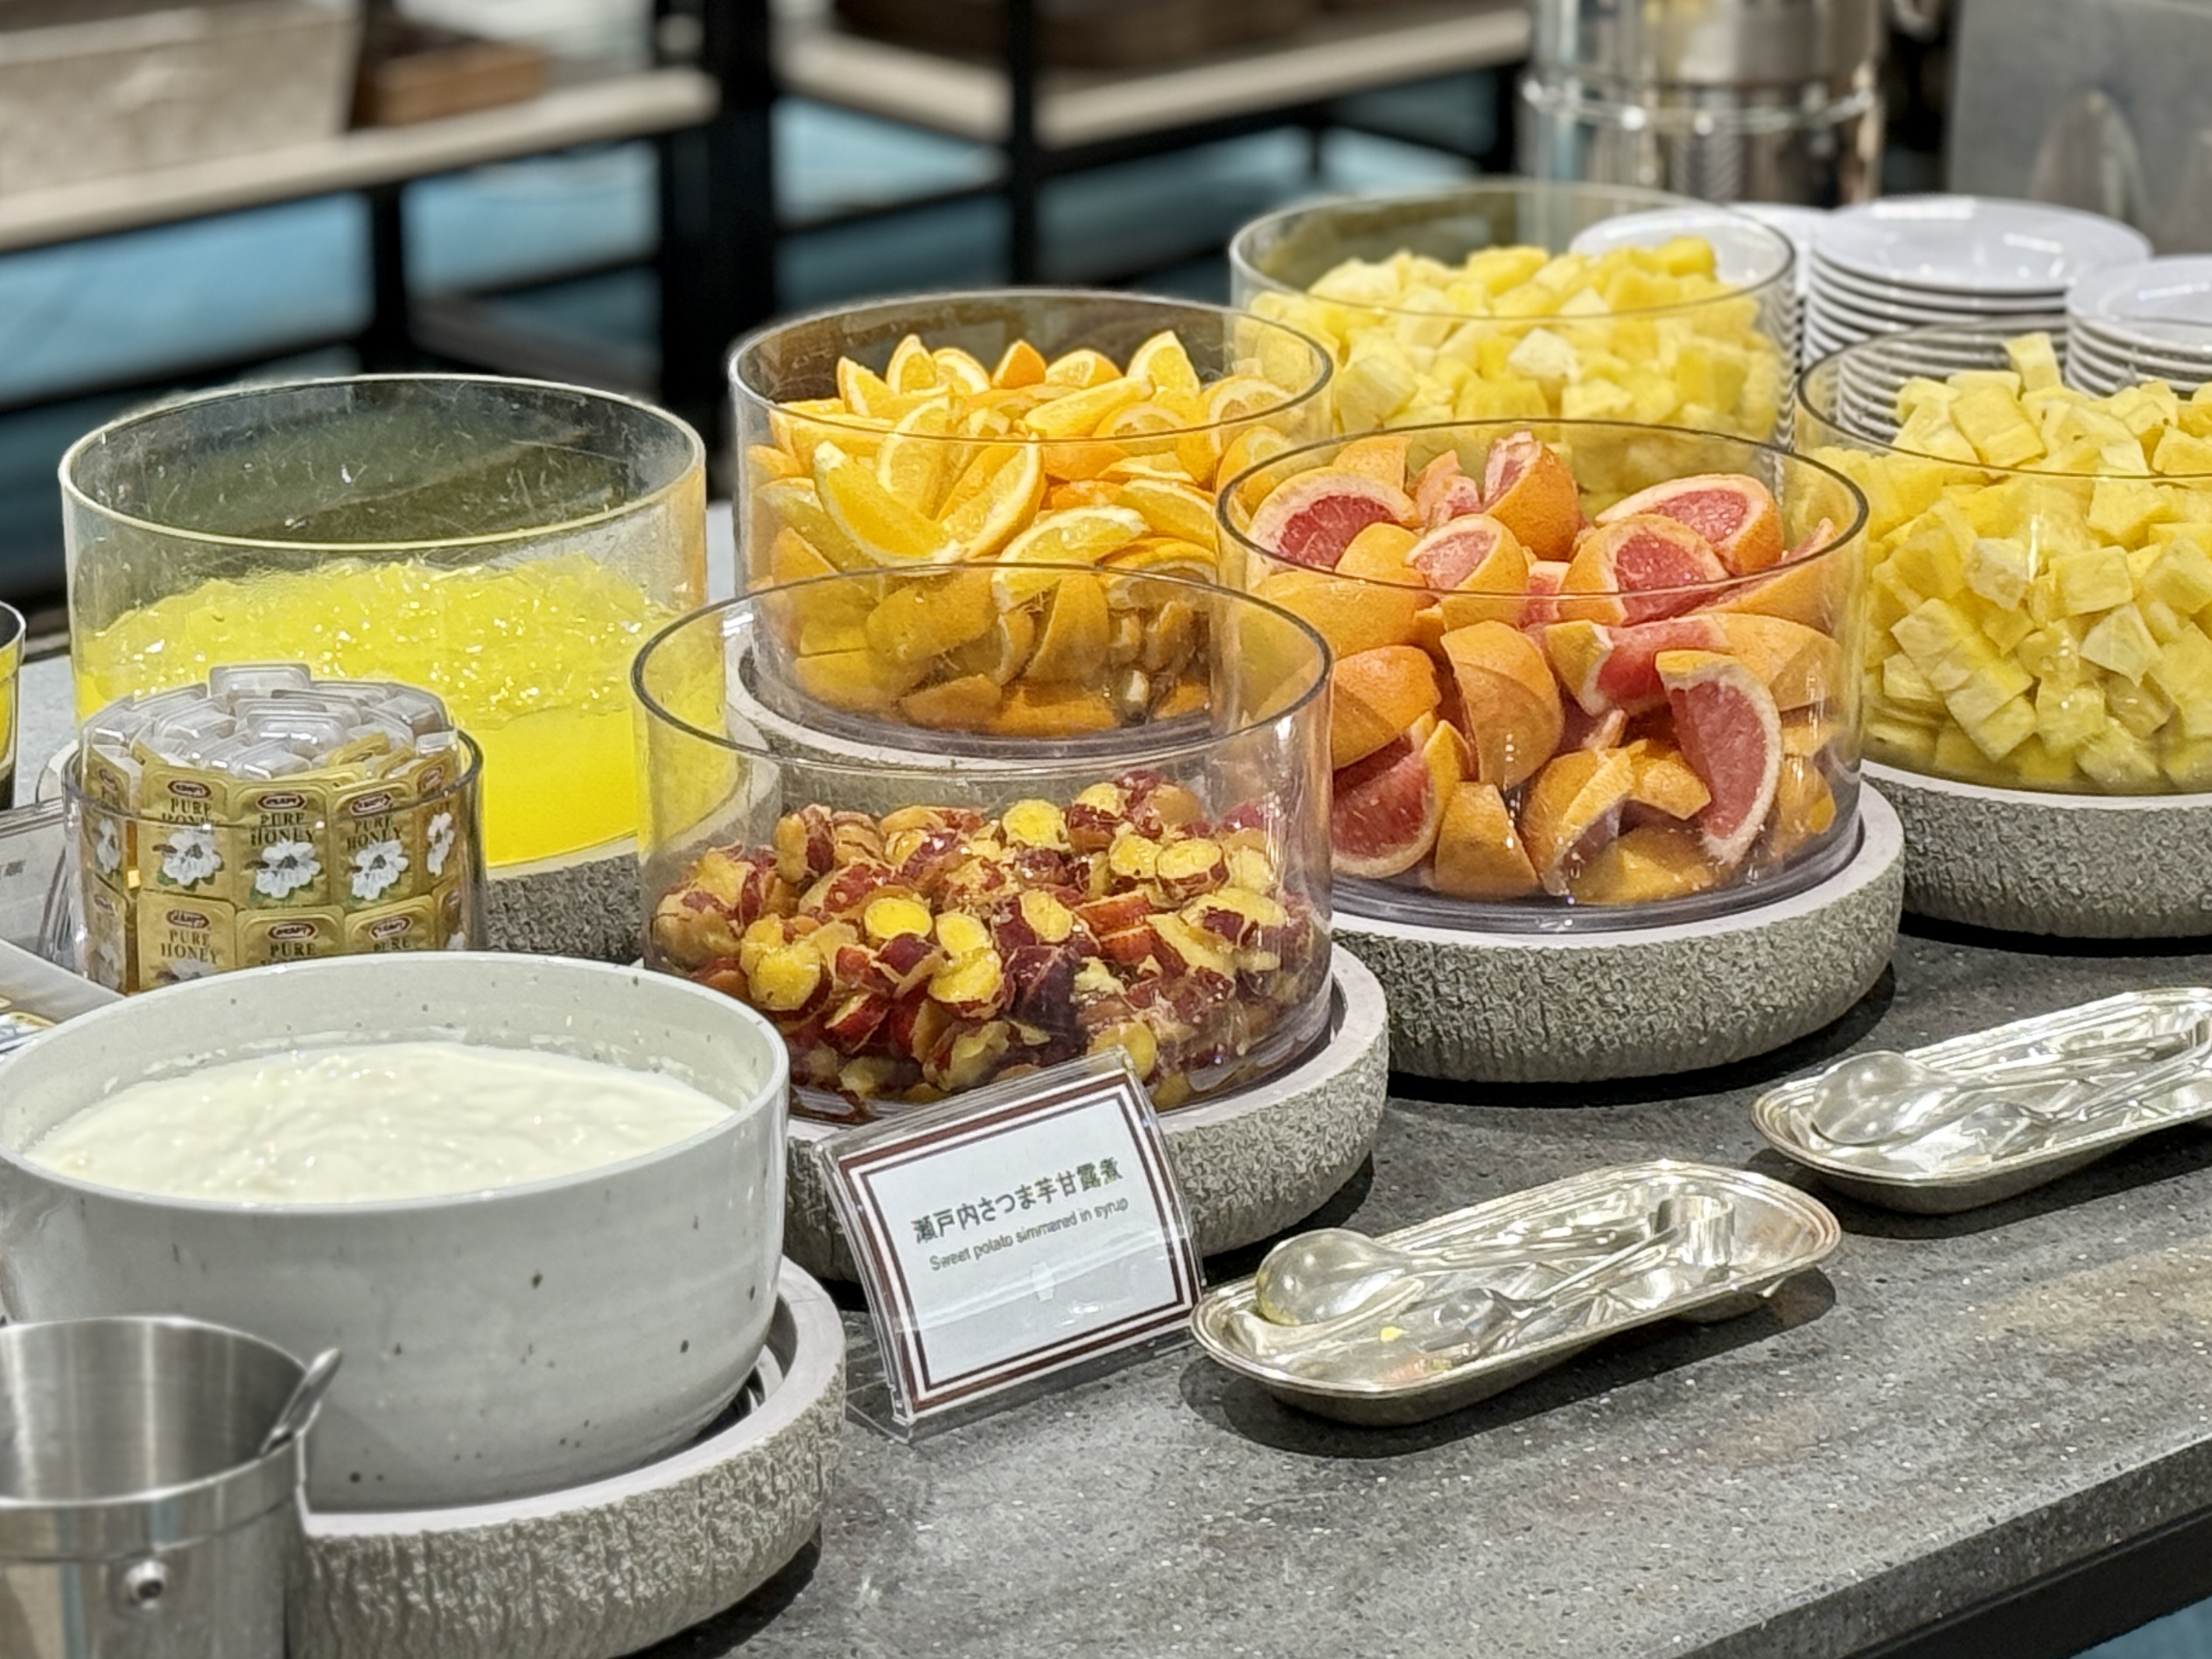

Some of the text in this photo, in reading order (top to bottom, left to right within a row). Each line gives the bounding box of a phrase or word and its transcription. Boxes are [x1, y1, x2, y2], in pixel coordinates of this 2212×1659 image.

[260, 812, 305, 826] PURE
[354, 816, 394, 835] PURE
[250, 825, 313, 845] HONEY
[347, 827, 401, 851] HONEY
[169, 929, 210, 947] PURE
[161, 943, 217, 965] HONEY
[270, 942, 317, 957] PURE
[911, 1157, 1123, 1244] 瀬戸内さつま芋甘露煮
[929, 1247, 971, 1271] Sweet
[972, 1234, 1014, 1261] potato
[1080, 1207, 1093, 1222] in
[1094, 1197, 1129, 1219] syrup
